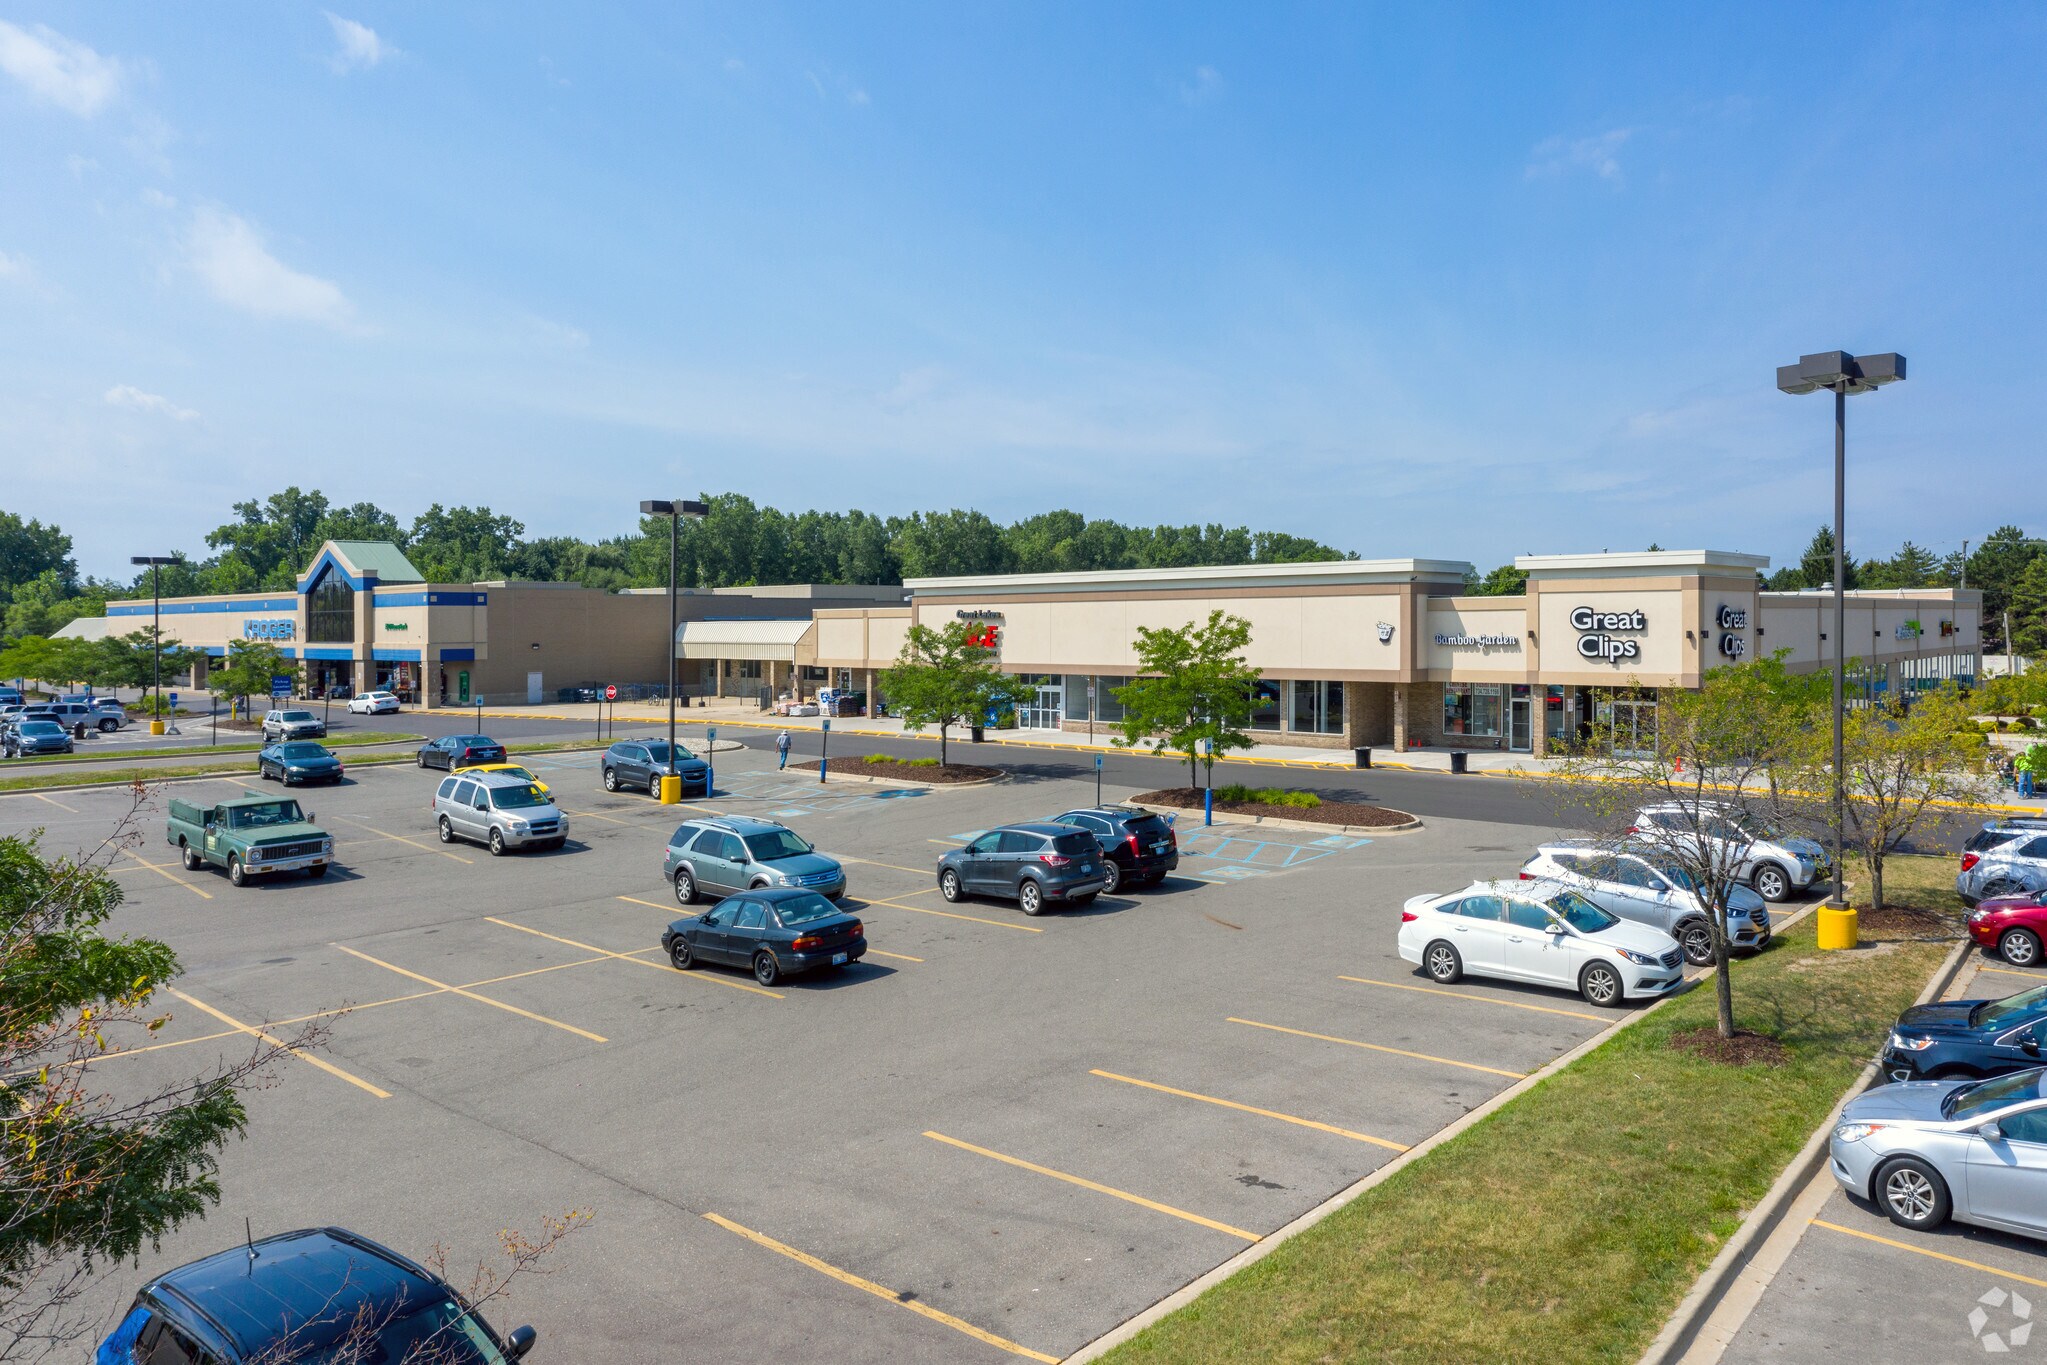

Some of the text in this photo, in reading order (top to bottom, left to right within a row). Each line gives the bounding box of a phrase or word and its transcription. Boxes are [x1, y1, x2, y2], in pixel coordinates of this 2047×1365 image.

[956, 609, 1003, 618] Great Lakes
[1570, 606, 1644, 631] Great
[1720, 606, 1748, 629] Great
[244, 619, 295, 639] KROGER
[1435, 632, 1516, 648] Bamboo Garden
[1577, 633, 1639, 663] Clips
[1722, 632, 1746, 658] Clips
